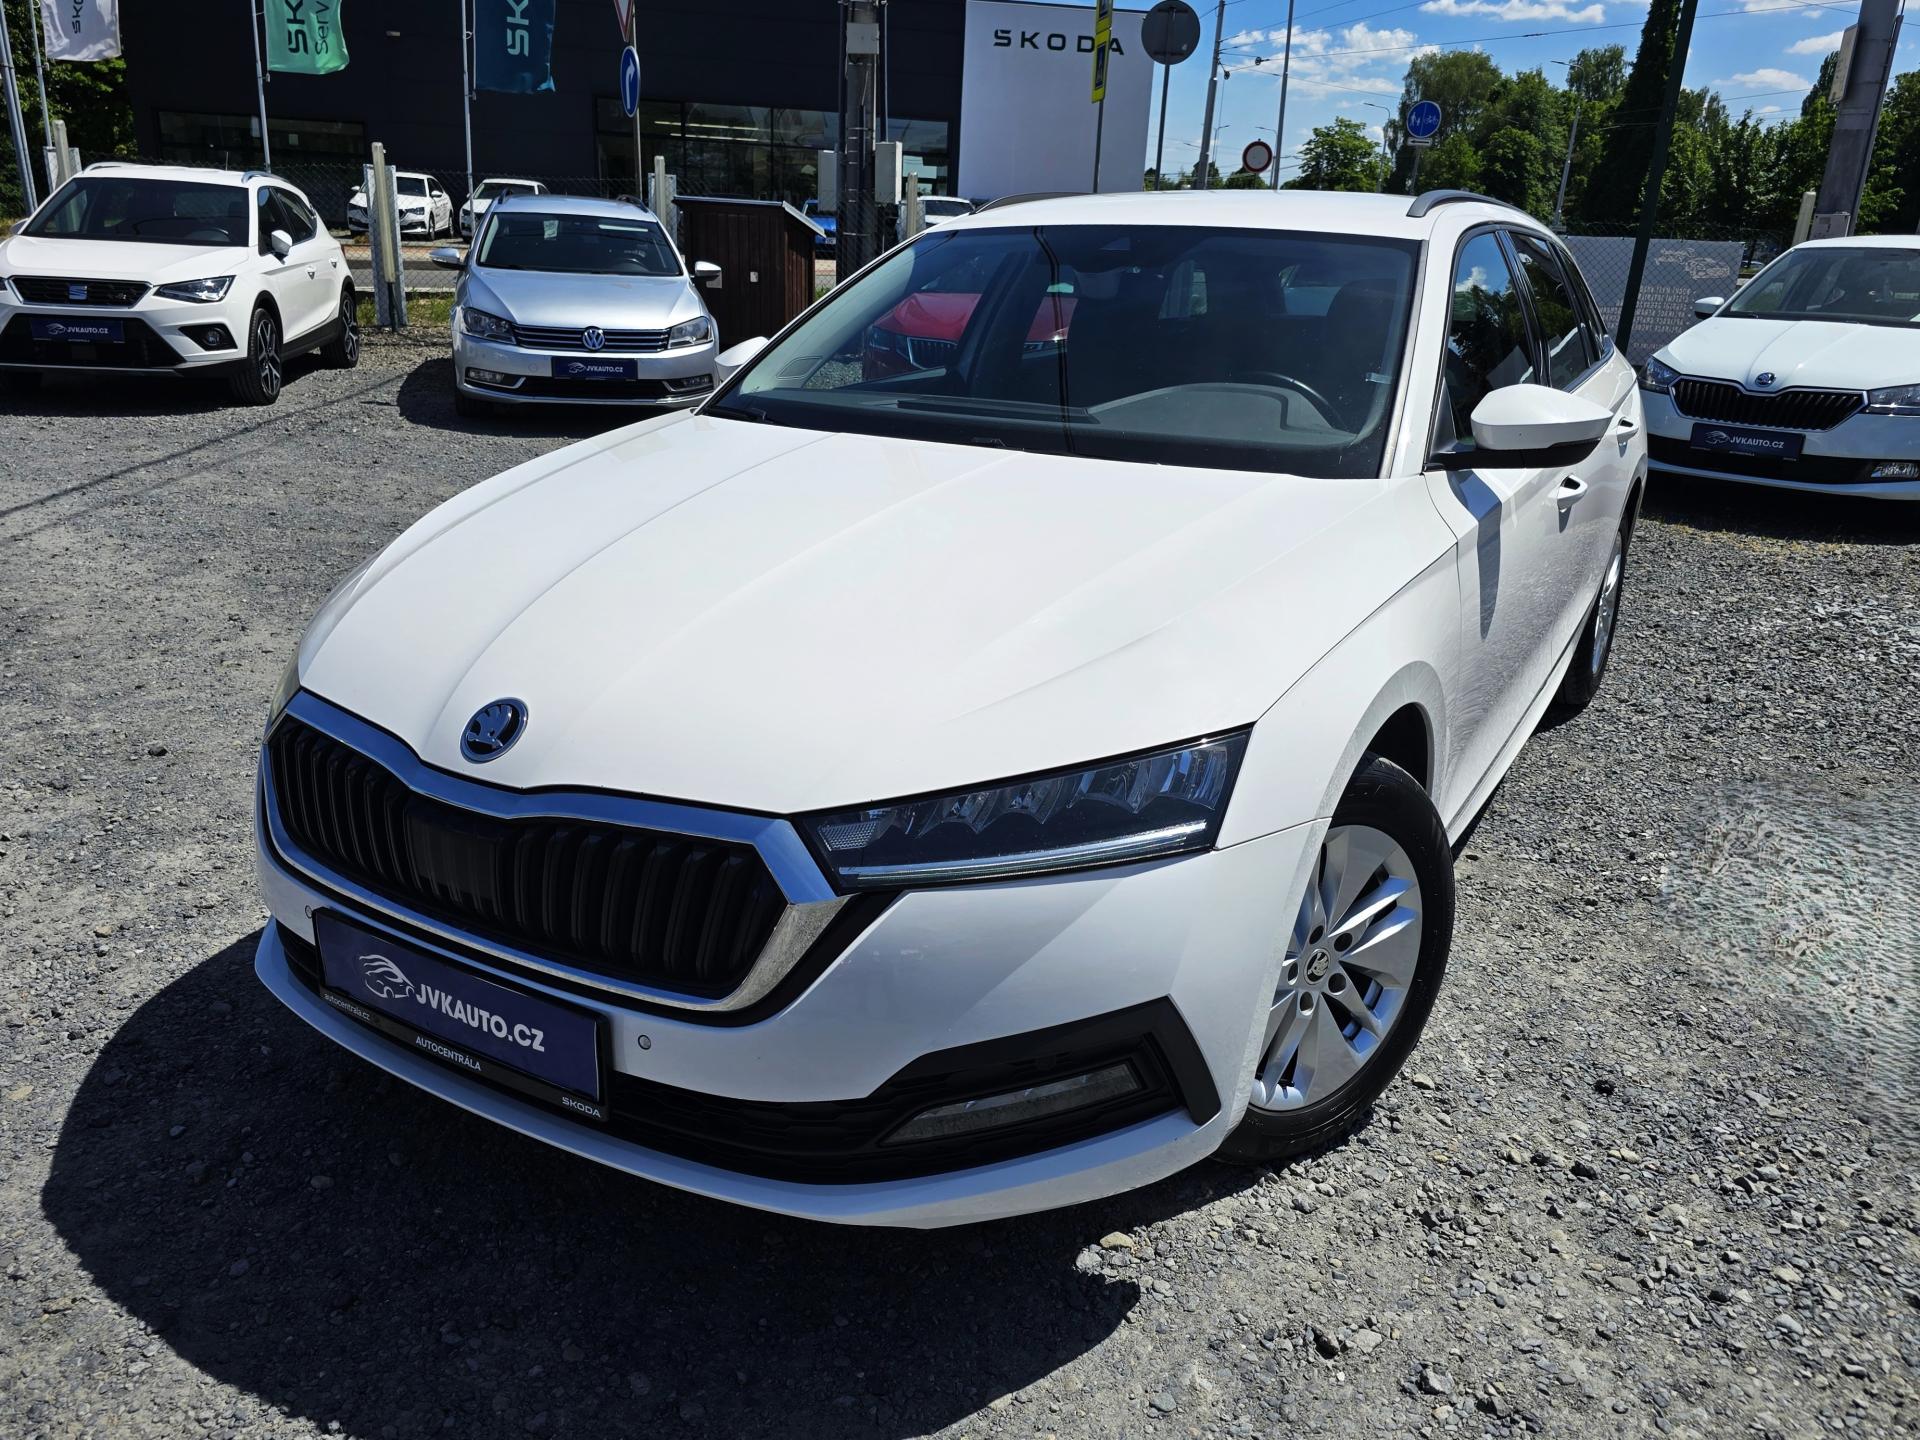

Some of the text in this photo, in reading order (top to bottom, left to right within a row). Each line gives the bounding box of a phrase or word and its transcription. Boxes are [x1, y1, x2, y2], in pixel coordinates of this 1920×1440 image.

[67, 326, 109, 335] JVKAUTO.CZ
[586, 365, 624, 373] JVKAUTO.CZ
[1730, 436, 1785, 449] JVKAUTO.CZ
[416, 983, 545, 1052] JVKAUTO.CZ
[415, 1035, 482, 1072] AUTOCENTRÁLA
